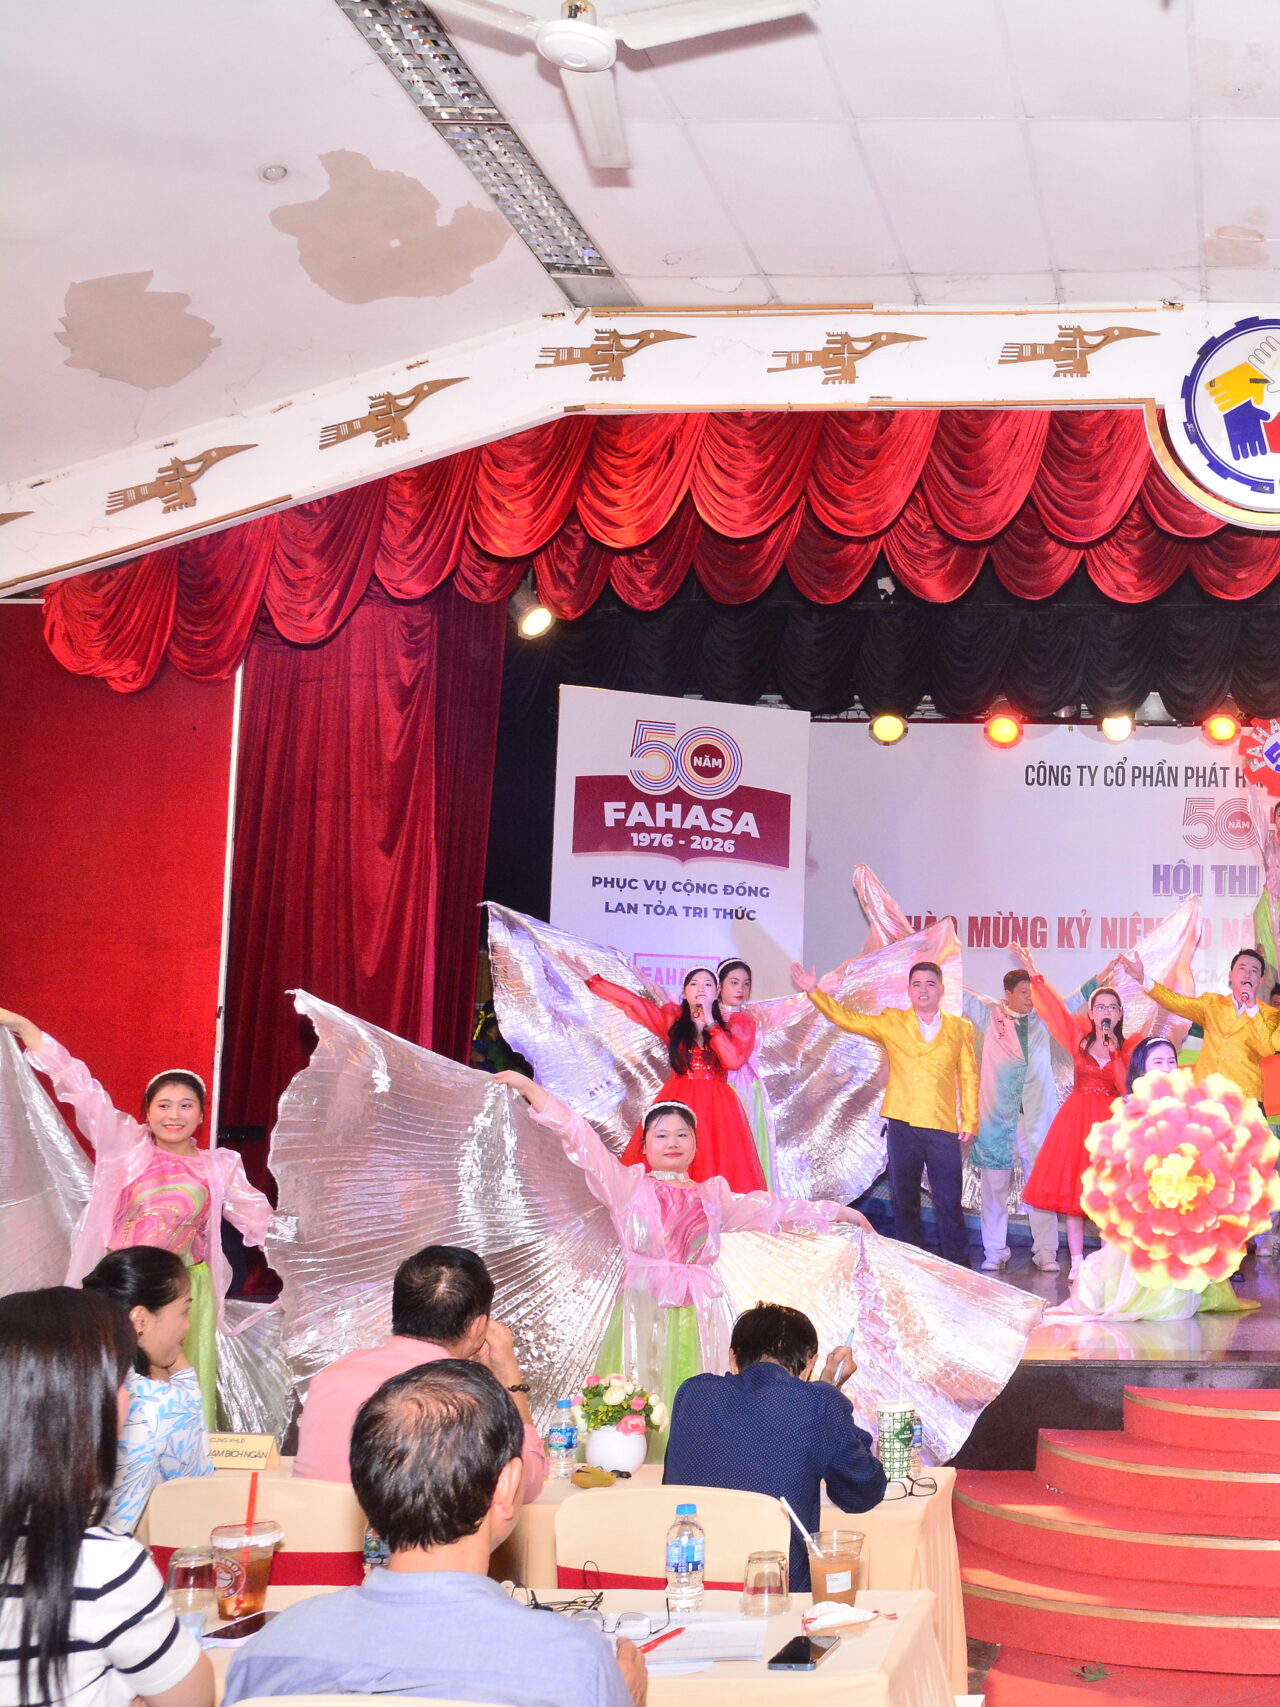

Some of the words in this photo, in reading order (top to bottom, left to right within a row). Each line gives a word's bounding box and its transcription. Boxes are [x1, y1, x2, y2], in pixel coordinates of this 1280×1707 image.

[630, 719, 742, 797] 50
[693, 755, 722, 769] NĂM
[1024, 761, 1071, 787] CÔNG
[1077, 765, 1098, 787] TY
[1103, 756, 1128, 787] CỔ
[1131, 759, 1179, 788] PHẦN
[1184, 761, 1230, 788] PHÁT
[603, 801, 760, 839] FAHASA
[631, 833, 673, 848] 1976
[690, 835, 735, 853] 2026
[592, 876, 639, 892] PHỤC
[643, 879, 667, 893] VỤ
[672, 879, 718, 896] CỘNG
[723, 881, 770, 898] ĐỒNG
[1152, 859, 1203, 901] HỘI
[1211, 864, 1258, 897] THI
[604, 901, 638, 915] LAN
[682, 905, 708, 919] TRI
[713, 905, 756, 921] THỨC
[968, 911, 1047, 949] MỪNG
[1057, 909, 1092, 949] KỶ
